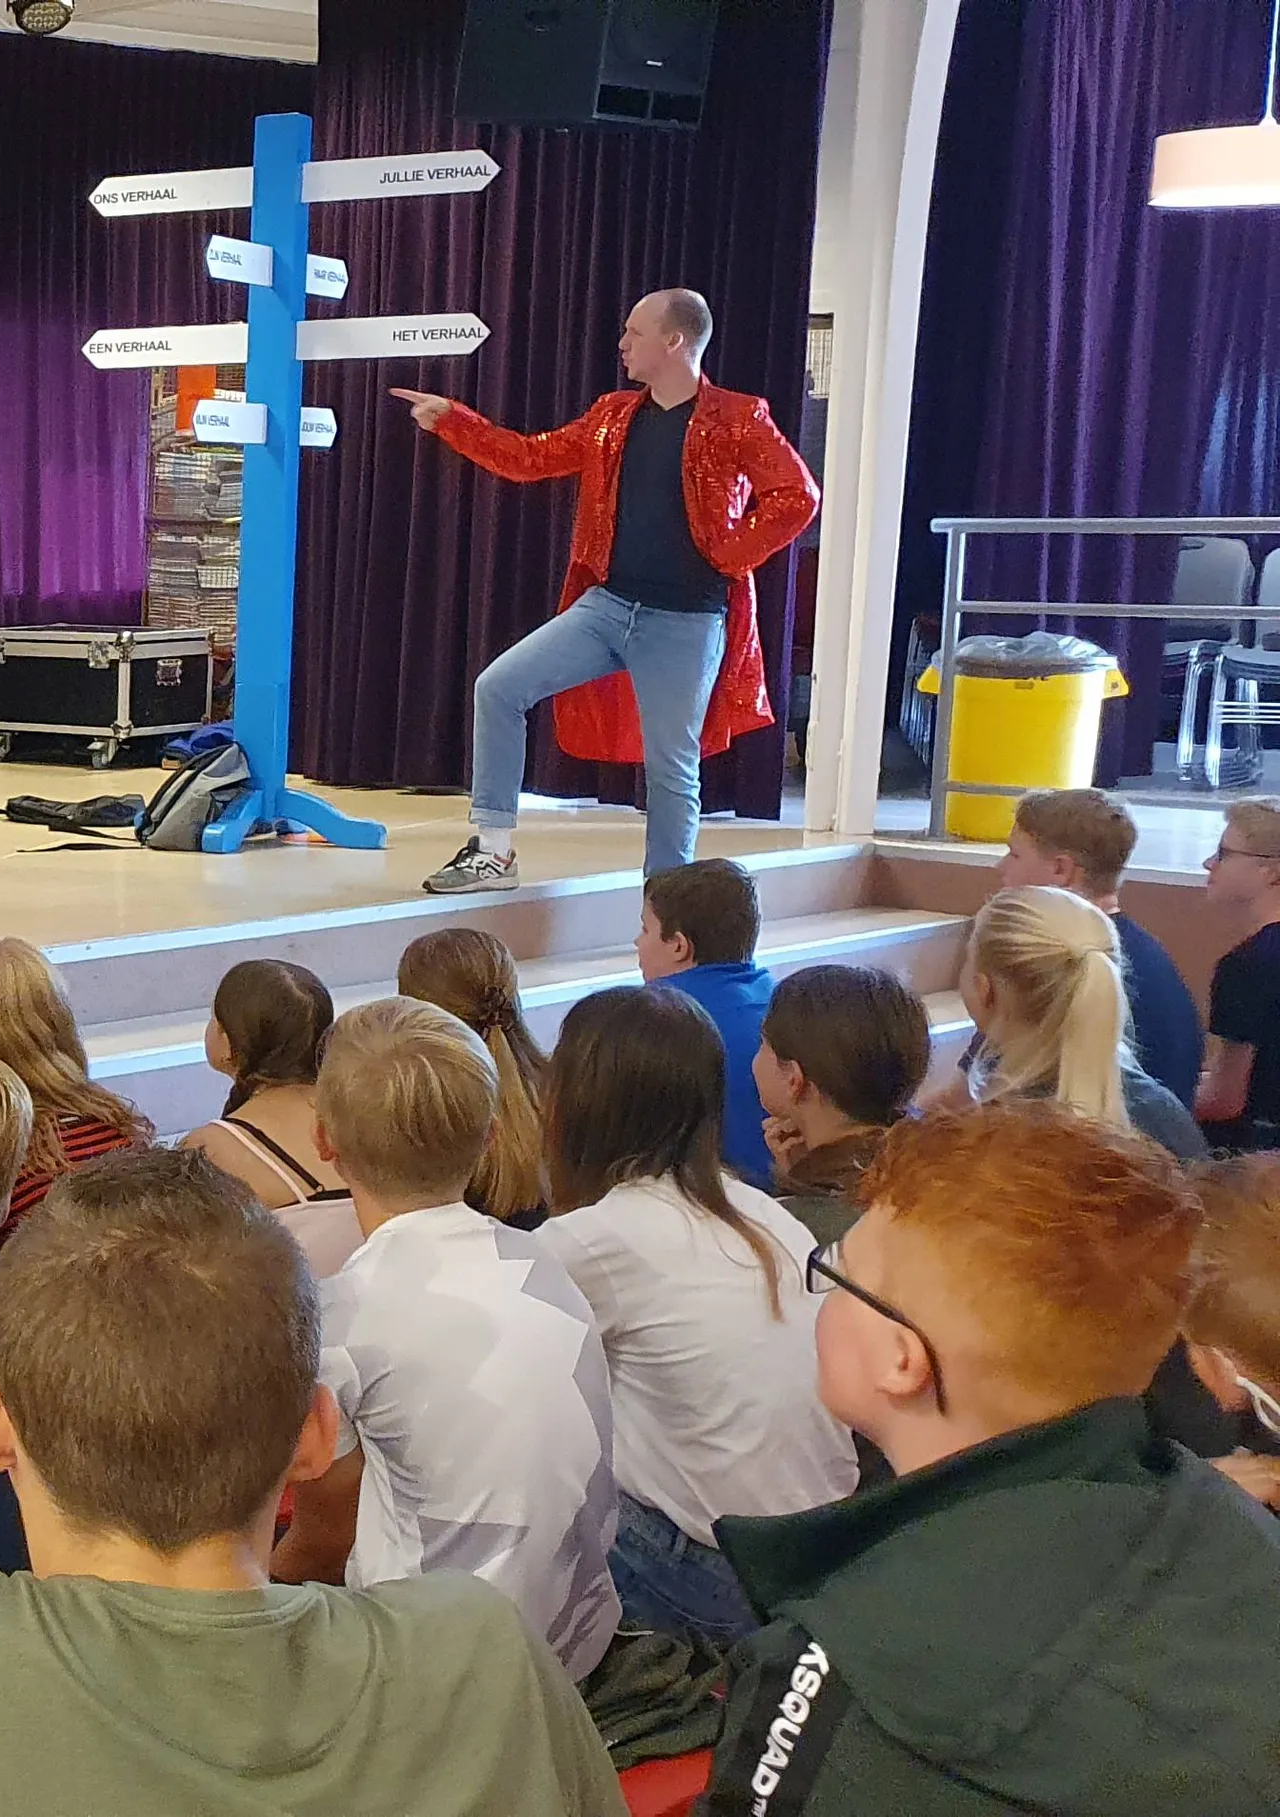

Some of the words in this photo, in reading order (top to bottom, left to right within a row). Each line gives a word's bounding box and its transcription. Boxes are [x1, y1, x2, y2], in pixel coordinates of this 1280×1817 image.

[380, 170, 424, 184] JULLIE
[427, 165, 491, 180] VERHAAL
[93, 193, 118, 204] ONS
[121, 187, 178, 203] VERHAAL
[393, 329, 419, 342] HET
[421, 326, 485, 341] VERHAAL
[89, 343, 113, 354] EEN
[115, 340, 172, 353] VERHAAL
